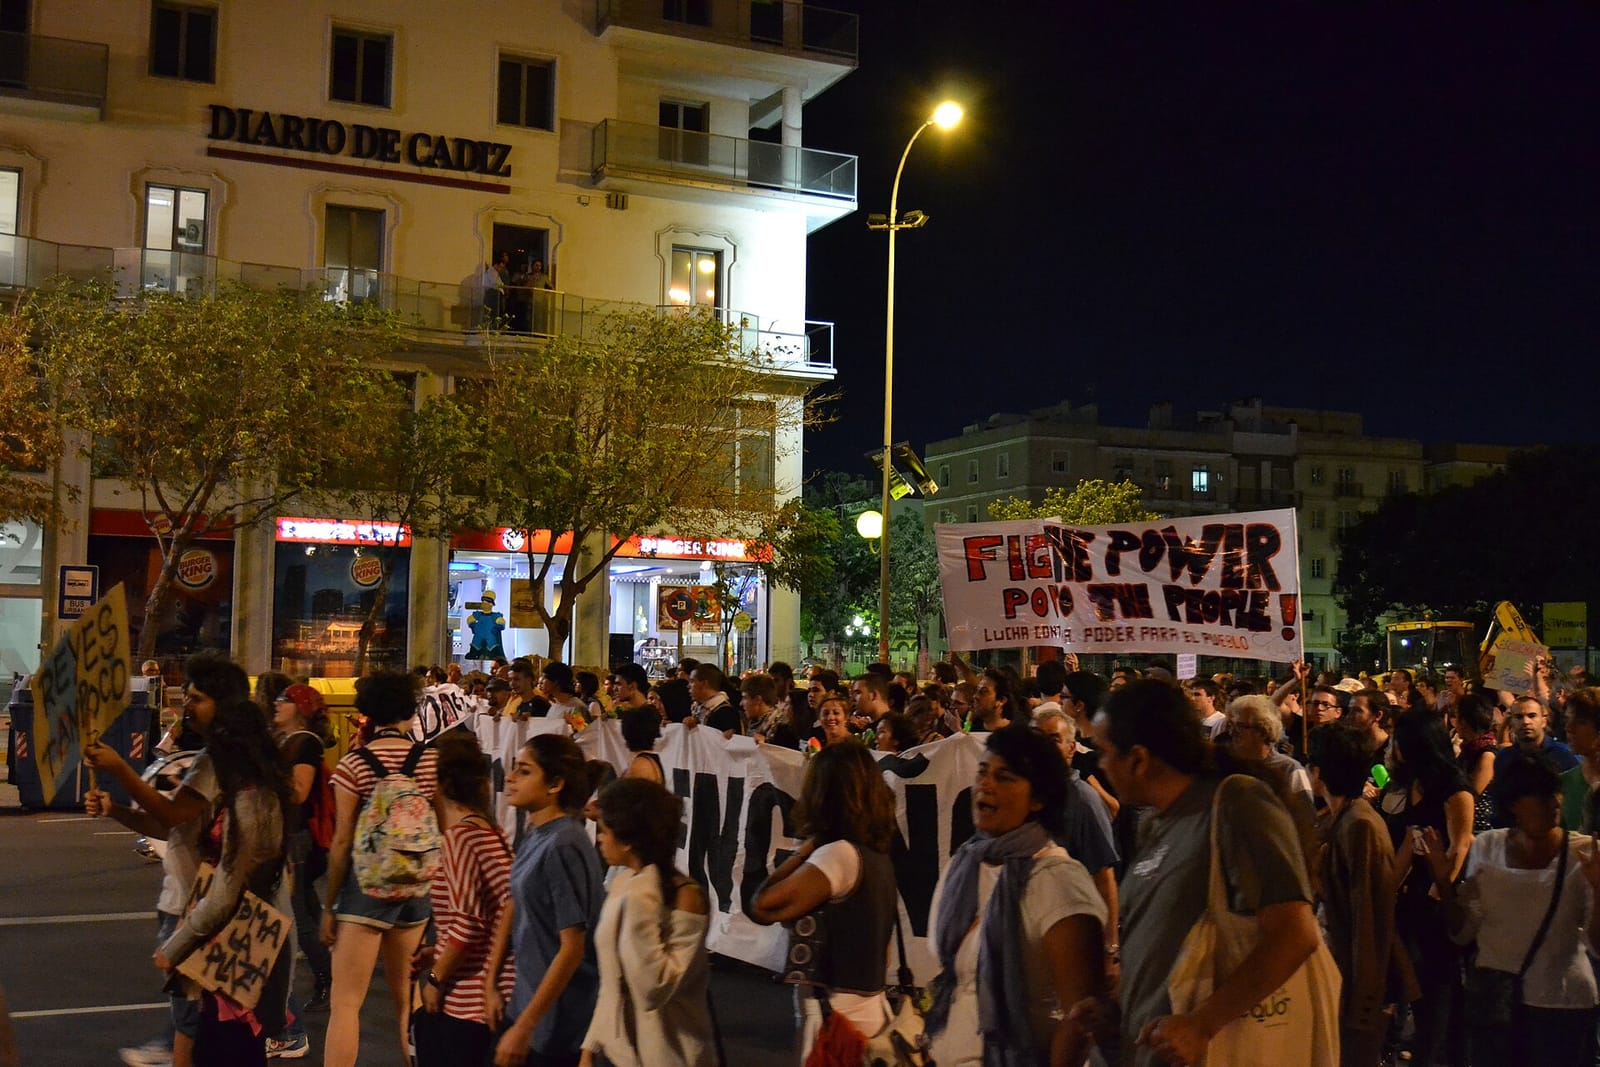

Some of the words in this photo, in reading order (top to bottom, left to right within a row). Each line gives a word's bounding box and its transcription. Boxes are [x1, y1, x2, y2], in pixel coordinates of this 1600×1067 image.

[207, 104, 346, 155] DIARIO
[351, 124, 402, 164] DE
[407, 132, 513, 178] CADIZ
[179, 555, 211, 570] BURGER
[354, 560, 379, 572] BURGER
[1104, 523, 1282, 592] POWER
[180, 562, 212, 579] KING
[355, 566, 381, 580] KING
[70, 600, 85, 608] BUS
[983, 625, 1030, 643] LUCHA
[1084, 626, 1136, 644] PODER
[1140, 626, 1177, 643] PARA
[1183, 631, 1200, 645] EL
[40, 604, 119, 706] REYES
